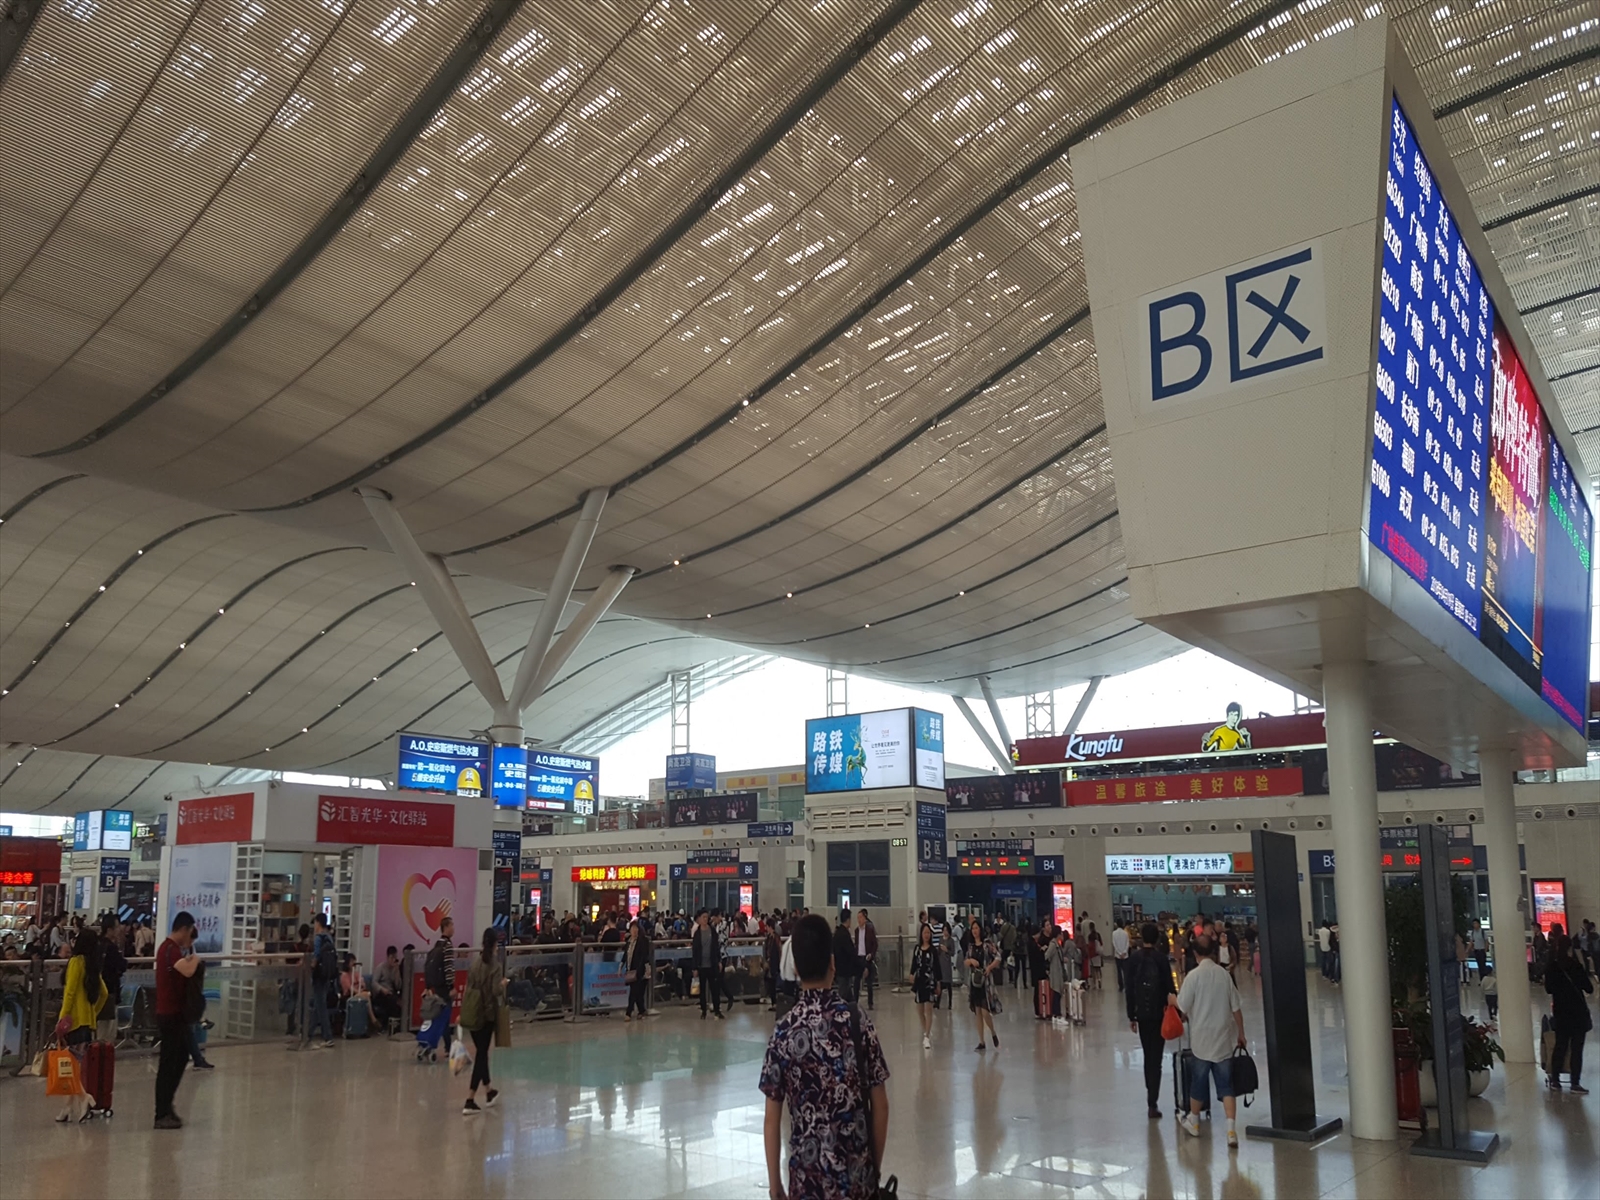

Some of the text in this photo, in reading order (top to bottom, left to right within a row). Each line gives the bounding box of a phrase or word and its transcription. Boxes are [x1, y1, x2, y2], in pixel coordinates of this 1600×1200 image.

[1387, 171, 1404, 218] G6346
[1476, 338, 1485, 370] 正点
[1149, 248, 1323, 400] B区
[1382, 268, 1399, 312] G6218
[1473, 413, 1482, 443] 正点
[1380, 317, 1395, 355] D682
[1471, 450, 1480, 480] 正点
[1474, 375, 1483, 405] 正点
[1470, 488, 1479, 516] 正点
[1468, 524, 1477, 552] 正点
[1466, 562, 1476, 589] 正点
[813, 729, 843, 753] 路铁
[1065, 734, 1124, 760] Kungfu
[814, 751, 844, 776] 传媒
[1096, 775, 1269, 800] 温馨旅途 美好体验
[338, 806, 428, 827] 汇智光华·文化驿站
[579, 866, 646, 881] 绝味鸭脖 绝味鸭脖
[674, 867, 682, 876] B7
[744, 865, 753, 874] B6
[1043, 860, 1055, 870] B4
[1110, 858, 1227, 871] 优选 便利店 港澳台广东特产
